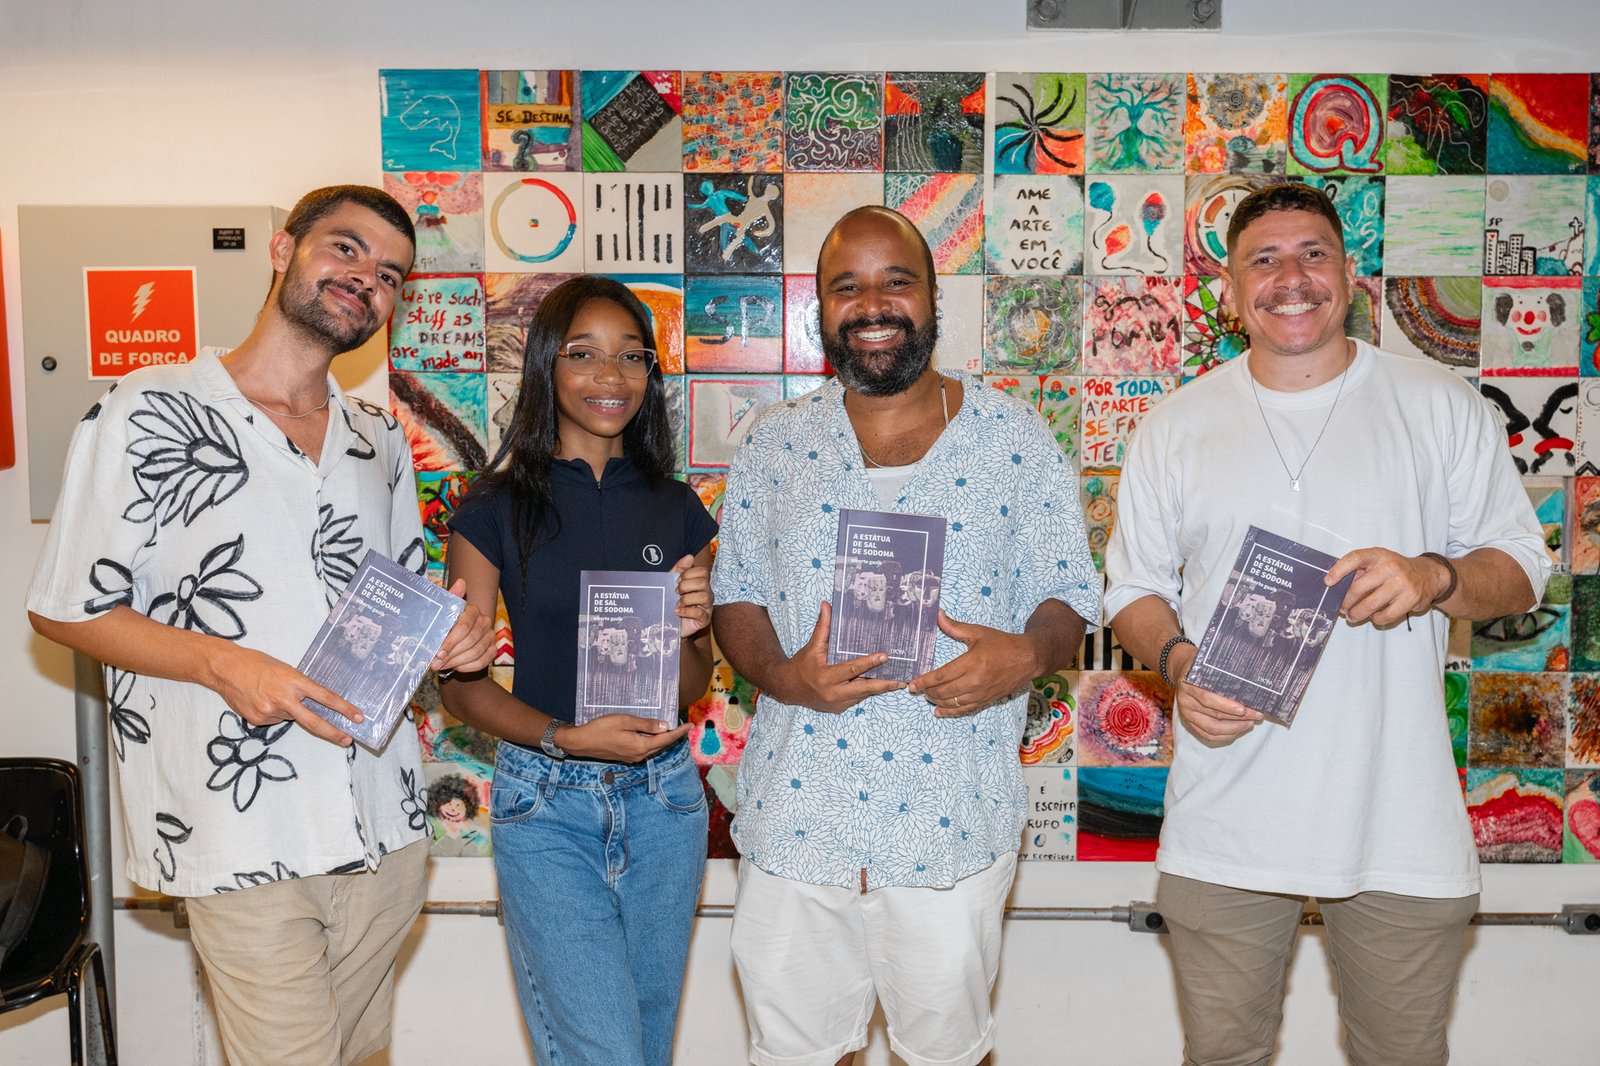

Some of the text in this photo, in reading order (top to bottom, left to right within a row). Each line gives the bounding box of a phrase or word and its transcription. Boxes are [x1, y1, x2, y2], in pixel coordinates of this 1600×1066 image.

[1016, 188, 1051, 200] AME
[1029, 204, 1039, 215] A
[1009, 219, 1052, 232] ARTE
[1019, 239, 1047, 252] EM
[1011, 249, 1062, 270] VOCÊ
[401, 288, 482, 306] We're such
[406, 306, 473, 331] stuff as
[699, 295, 776, 348] SP
[105, 329, 181, 344] QUADRO
[419, 331, 484, 347] DREAMS
[99, 352, 123, 365] DE
[391, 346, 419, 359] are
[422, 350, 460, 370] made
[1116, 380, 1163, 397] TODA
[1100, 397, 1149, 415] PARTE
[1084, 416, 1138, 437] SE FA
[860, 534, 890, 542] ESTÁTUA
[863, 549, 894, 558] SODOMA
[1253, 561, 1277, 574] DE SAL
[1262, 556, 1293, 573] ESTÁTUA
[1250, 568, 1292, 588] DE SODOMA
[365, 583, 388, 599] DE SAL
[375, 580, 404, 599] ESTÁTUA
[361, 590, 400, 615] DE SODOMA
